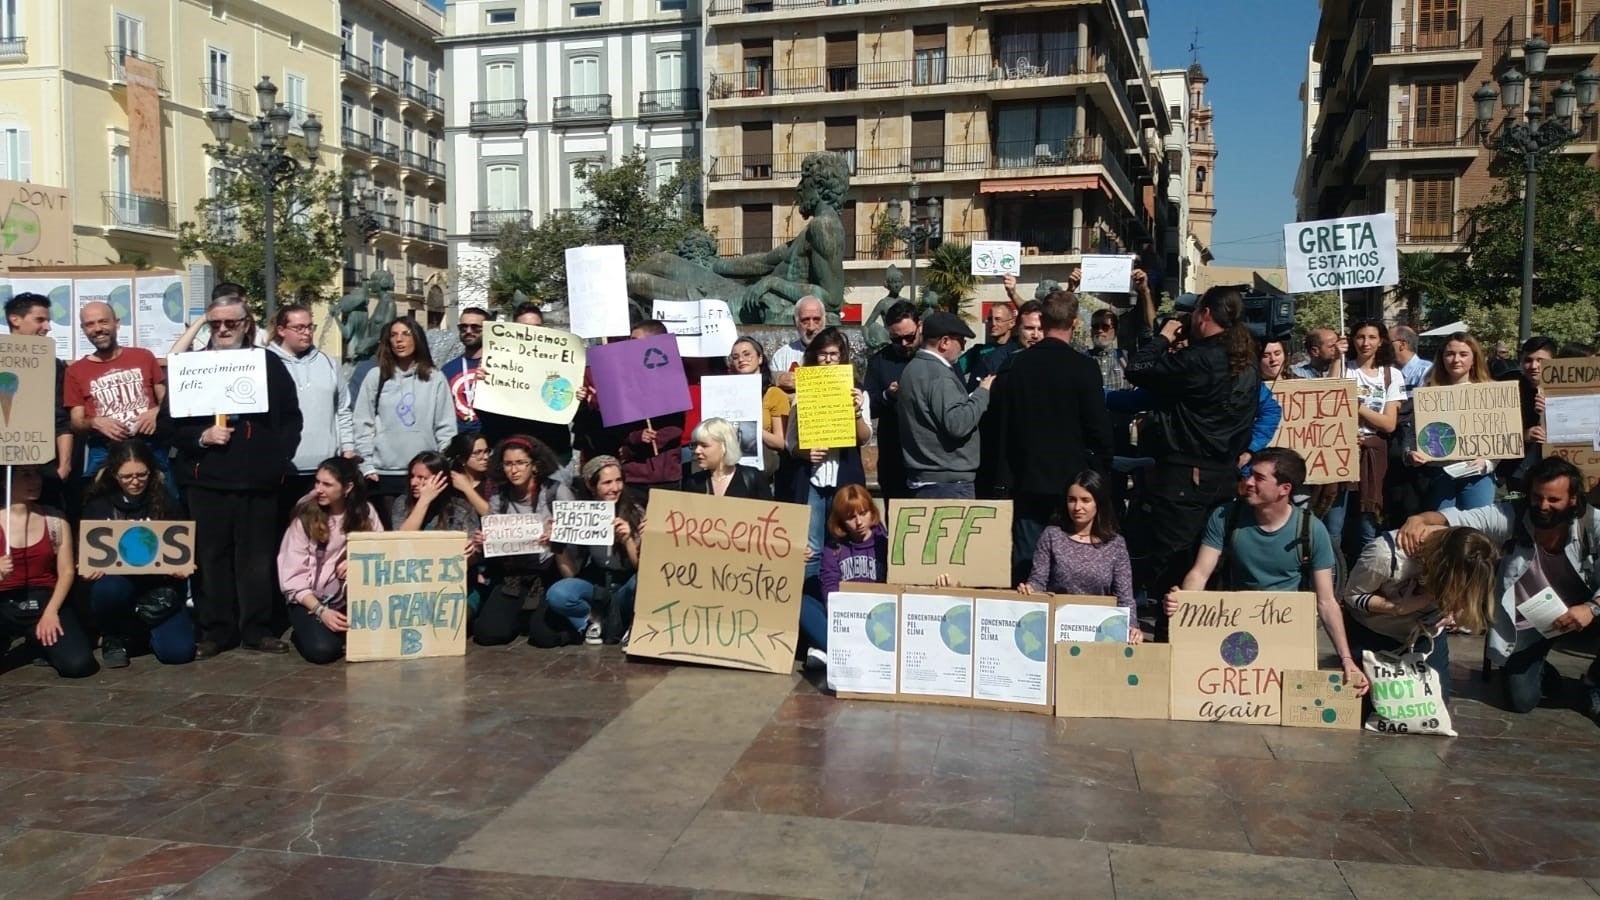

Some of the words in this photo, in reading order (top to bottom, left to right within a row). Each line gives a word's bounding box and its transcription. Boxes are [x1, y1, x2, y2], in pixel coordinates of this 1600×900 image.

[1298, 222, 1378, 254] GRETA
[1308, 251, 1380, 270] ESTAMOS
[1307, 267, 1385, 288] ¡CONTIGO!
[491, 324, 568, 347] Cambiemos
[31, 344, 48, 355] ES
[489, 340, 511, 353] Para
[561, 349, 575, 364] El
[179, 363, 256, 377] decrecimiento
[485, 355, 524, 373] Cambio
[178, 380, 204, 393] feliz
[1418, 390, 1456, 412] RESPETA
[1459, 389, 1471, 411] LA
[1474, 386, 1520, 410] EXISTENCIA
[1459, 414, 1467, 434] O
[24, 432, 48, 443] DEL
[1458, 432, 1523, 457] RESISTENCIA
[891, 505, 997, 566] FFF
[350, 553, 434, 587] THERE
[438, 554, 465, 583] IS
[351, 599, 383, 630] NO
[652, 600, 765, 661] FUTUR
[401, 628, 422, 656] B
[1197, 667, 1281, 697] GRETA
[1373, 680, 1415, 700] NOT
[1424, 682, 1433, 696] A
[1199, 701, 1278, 722] again
[1376, 701, 1437, 720] PLASTIC
[1377, 719, 1408, 733] BAG
